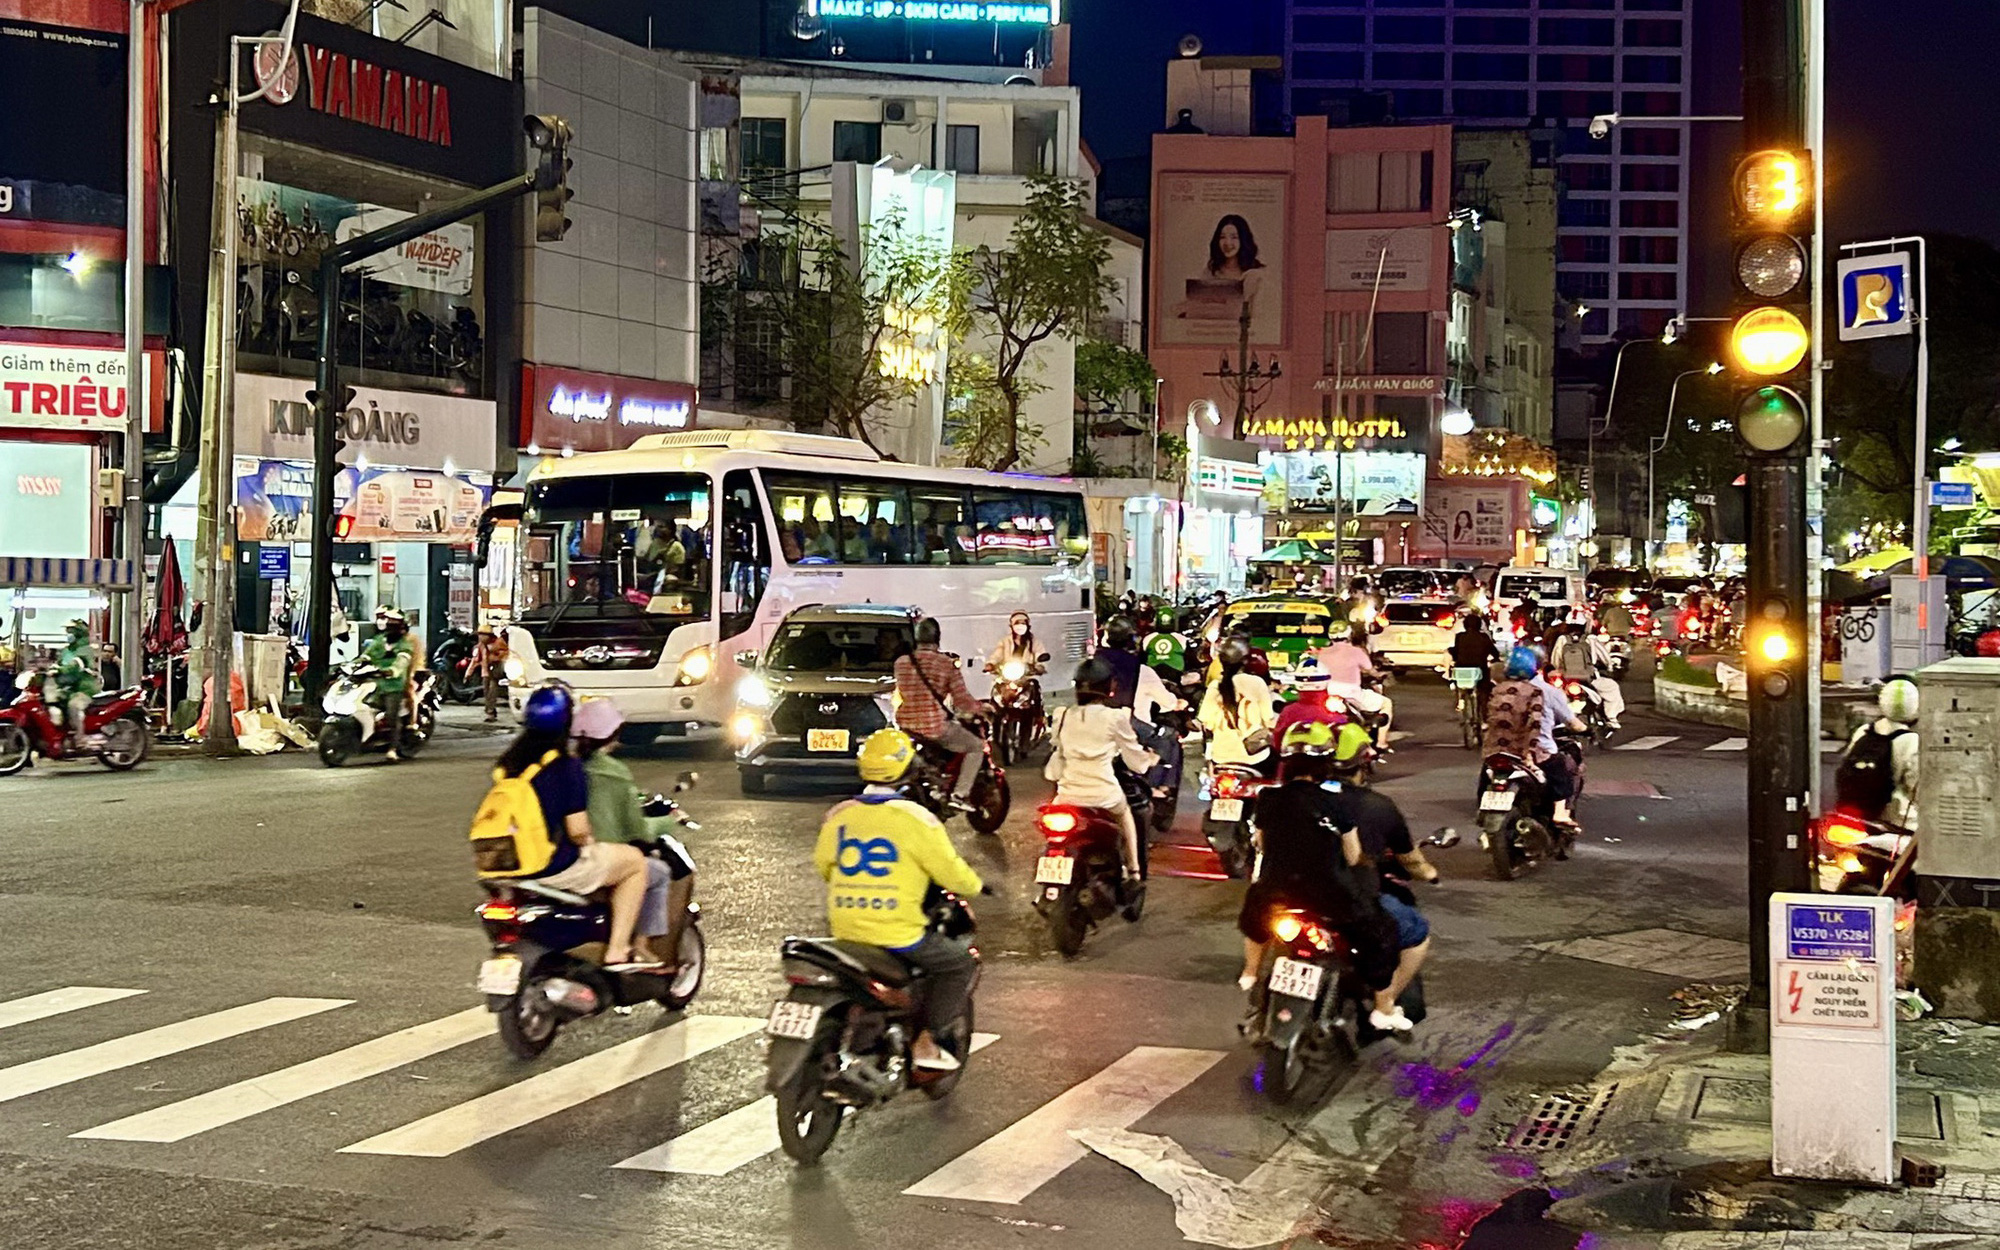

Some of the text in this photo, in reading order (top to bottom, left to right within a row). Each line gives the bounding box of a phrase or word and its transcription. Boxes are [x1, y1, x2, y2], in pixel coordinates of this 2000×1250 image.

[820, 2, 1049, 23] MAKE UP SKIN CARE PERFUME
[302, 43, 451, 147] YAMAHA
[405, 241, 462, 266] WANDER
[2, 354, 126, 376] Giảm thêm đến
[4, 376, 126, 425] TRIỆU
[838, 825, 899, 877] be
[1817, 911, 1845, 923] TLK
[1793, 927, 1828, 939] VS370
[1835, 929, 1869, 940] VS284
